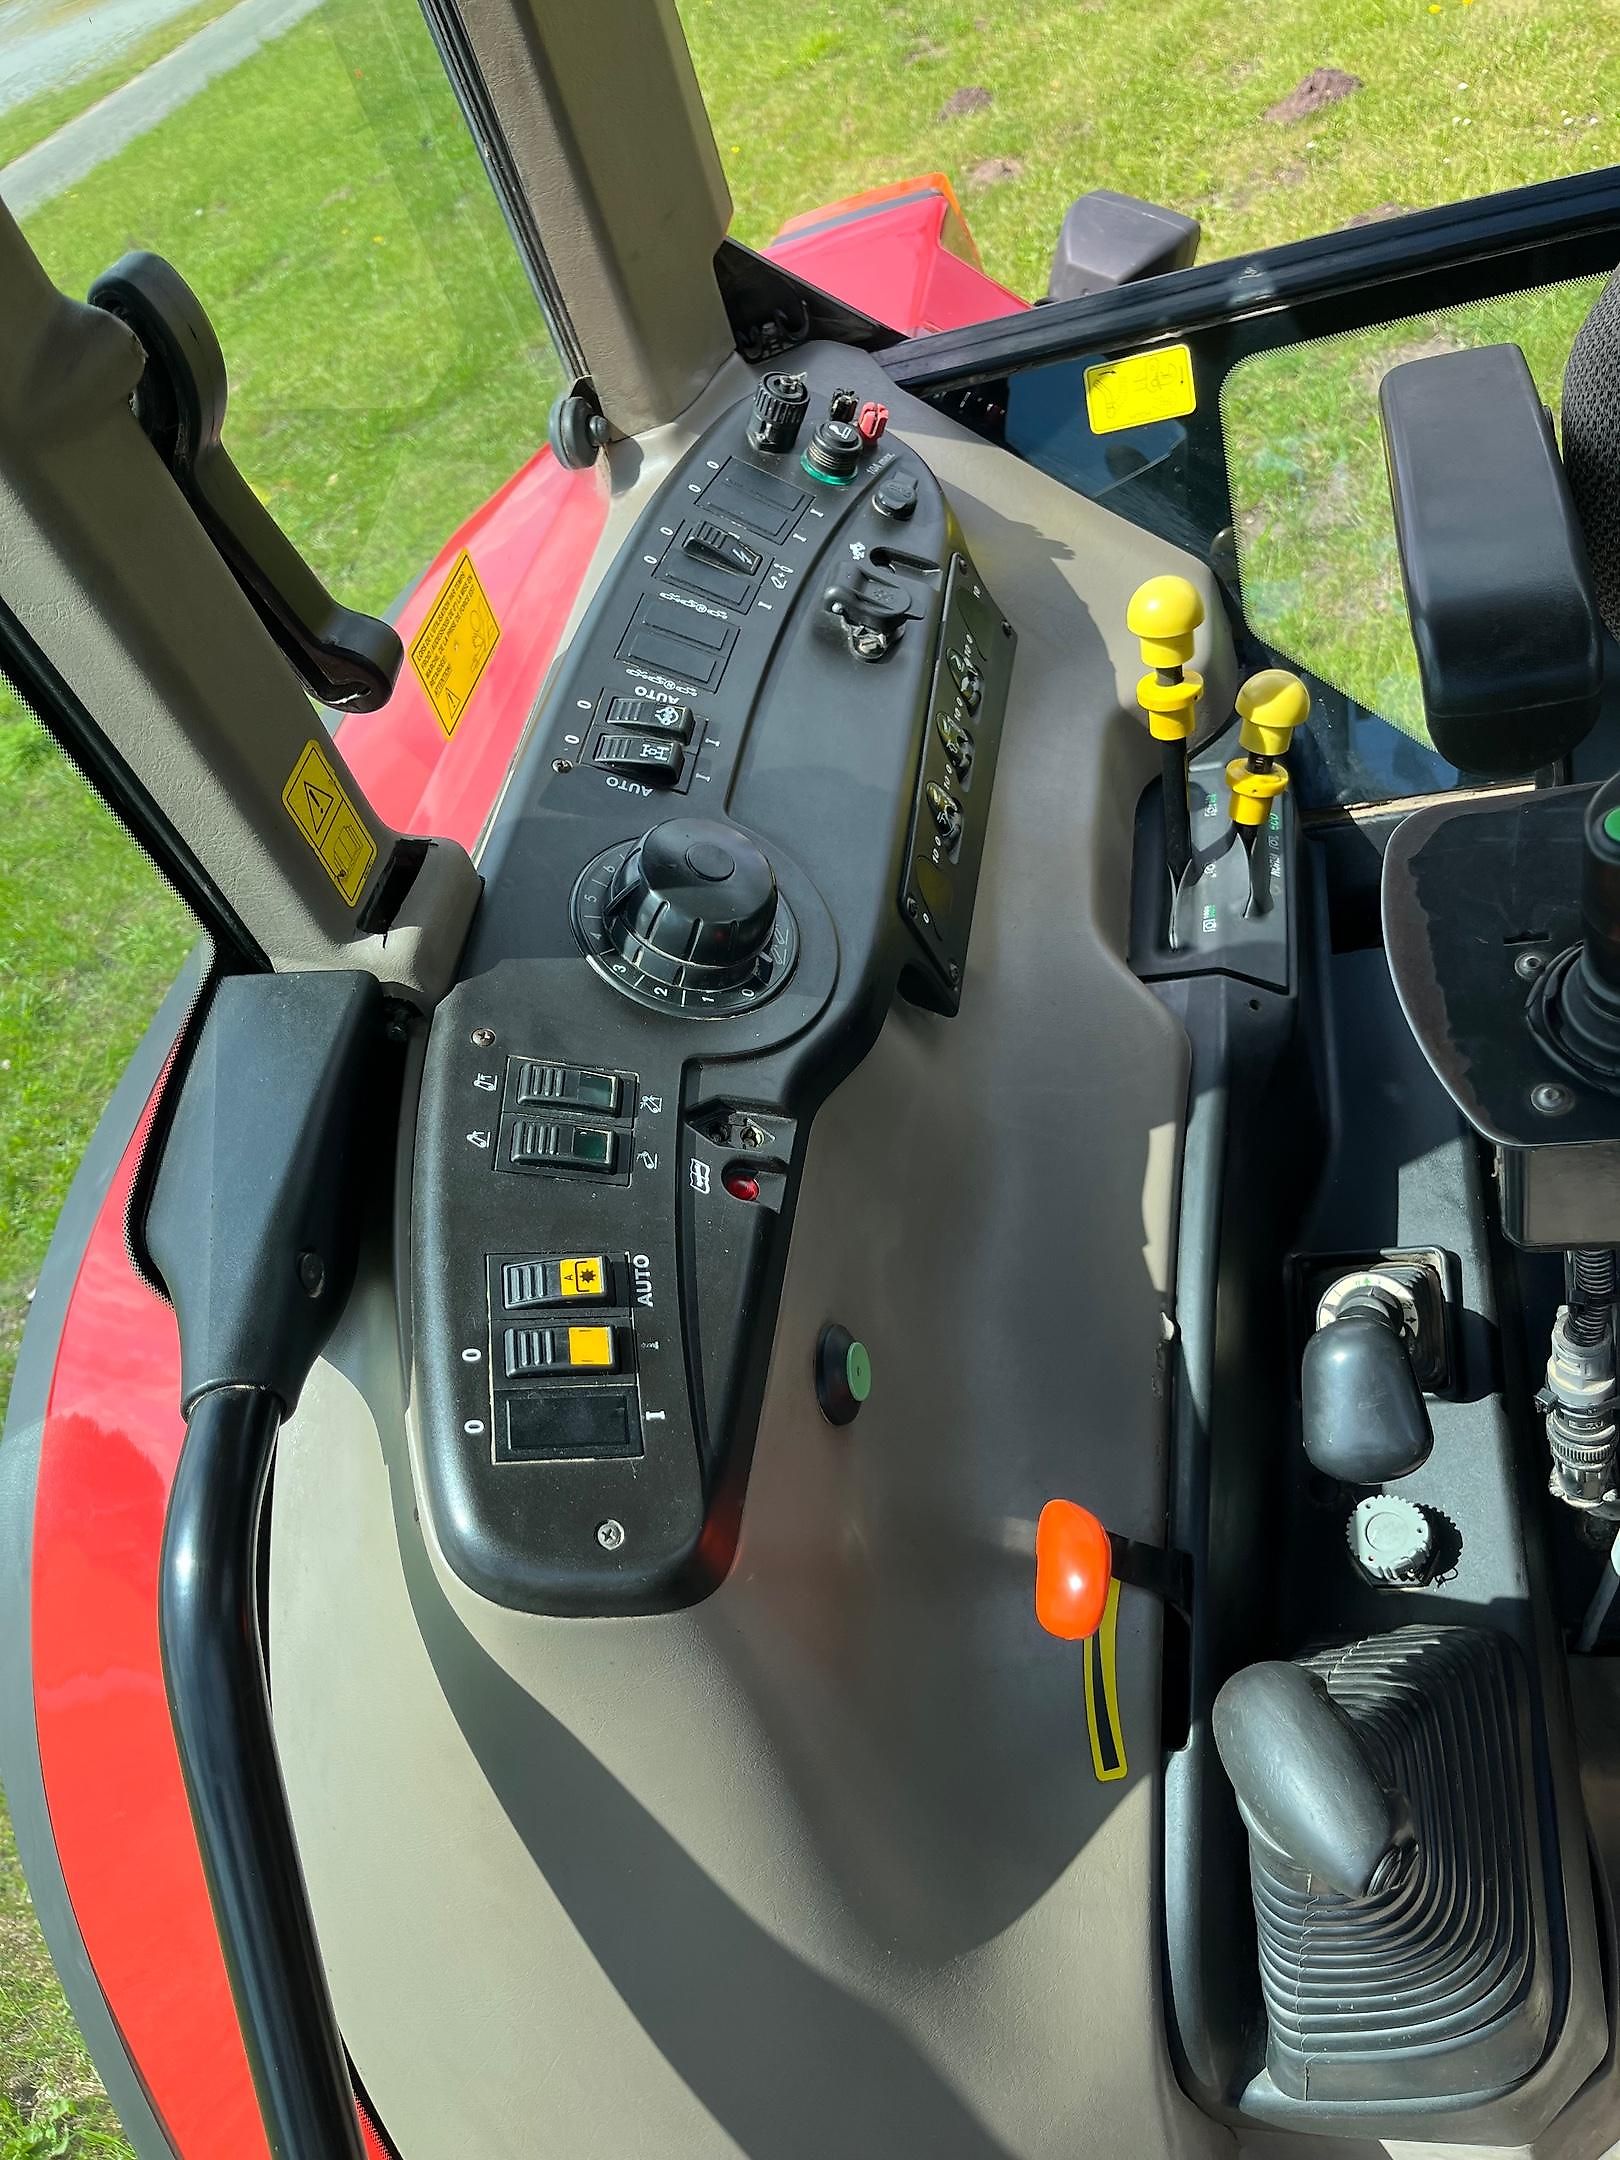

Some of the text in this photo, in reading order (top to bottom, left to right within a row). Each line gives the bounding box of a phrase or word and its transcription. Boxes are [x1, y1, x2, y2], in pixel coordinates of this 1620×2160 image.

[706, 460, 720, 470] 0
[688, 483, 702, 494] 0
[659, 526, 673, 536] 0
[643, 555, 657, 564] 0
[634, 685, 680, 705] AUTO
[576, 700, 592, 710] 0
[565, 734, 580, 744] 0
[606, 776, 654, 797] AUTO
[613, 964, 627, 974] 3
[654, 986, 667, 997] 2
[741, 988, 755, 1000] 0
[702, 995, 715, 1003] 1
[633, 1254, 654, 1307] AUTO
[462, 1348, 481, 1361] 0
[464, 1419, 484, 1434] 0
